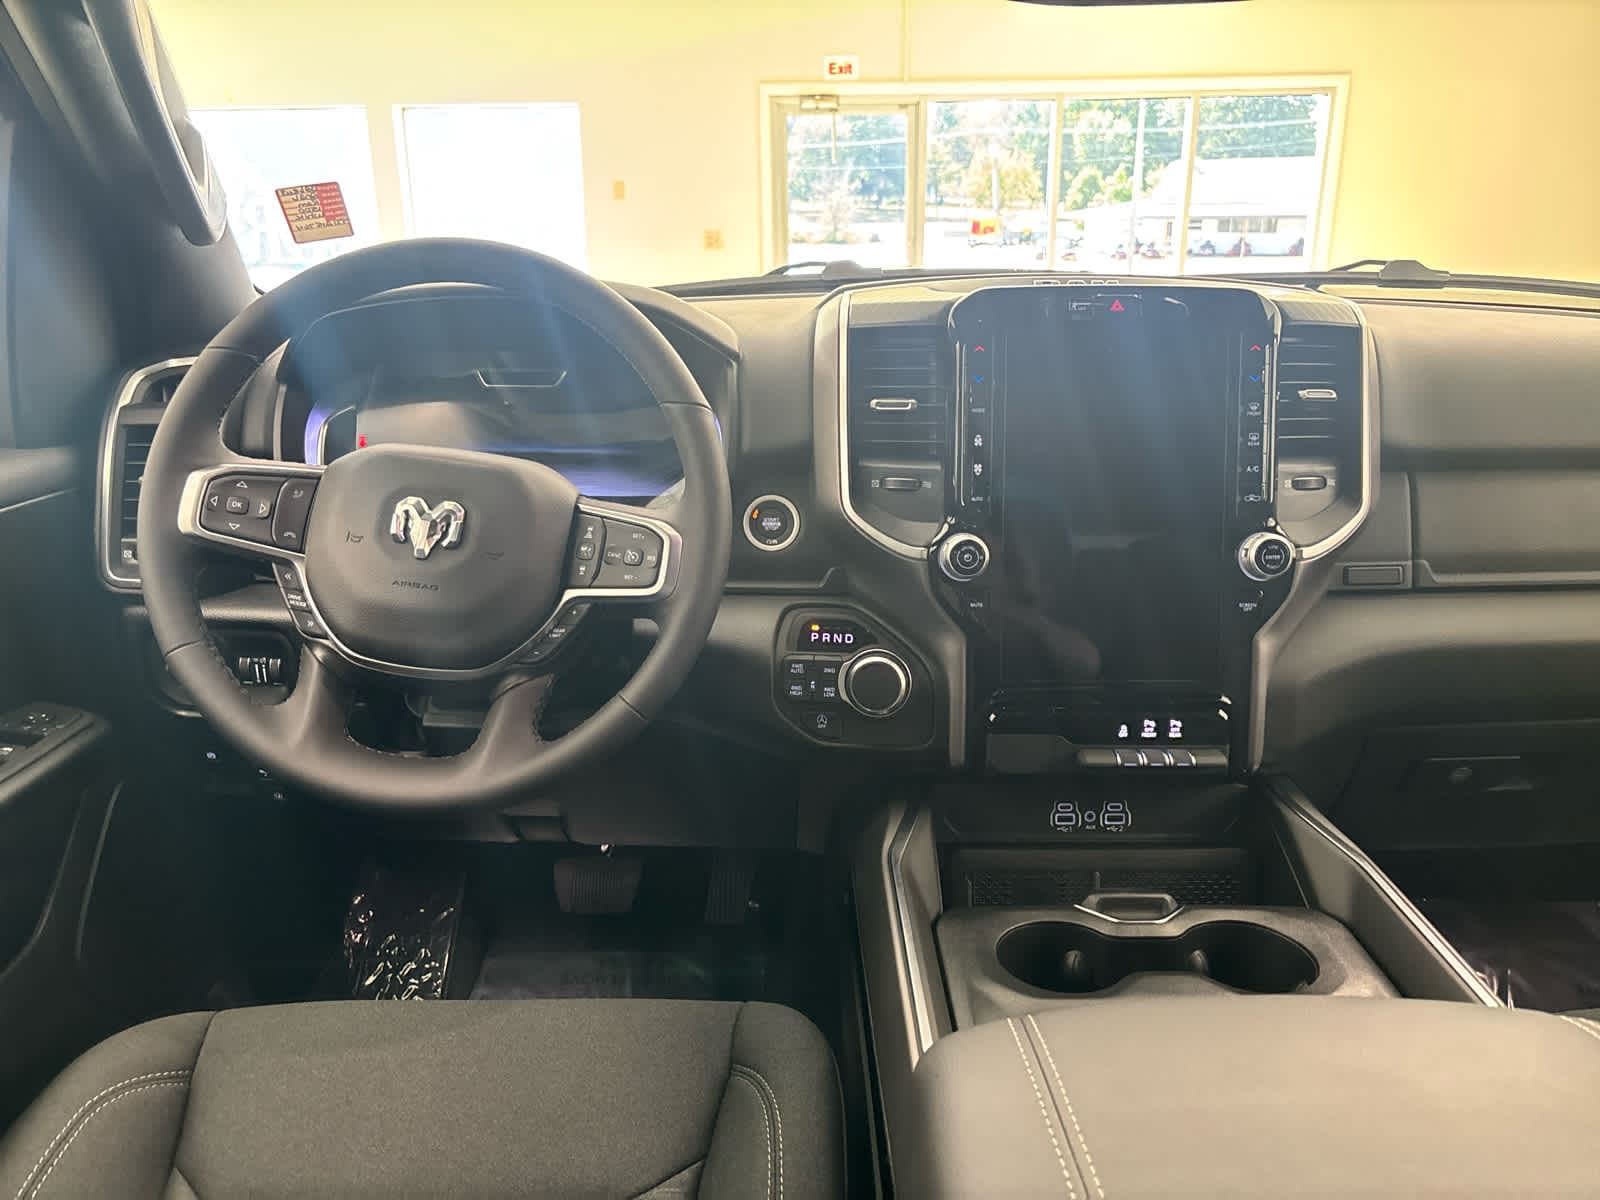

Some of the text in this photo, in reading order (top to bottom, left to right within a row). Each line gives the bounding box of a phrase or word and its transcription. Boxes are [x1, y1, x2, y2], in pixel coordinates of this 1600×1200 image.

[829, 62, 852, 75] Exit
[232, 501, 243, 509] OK
[391, 579, 440, 592] AIRBAG
